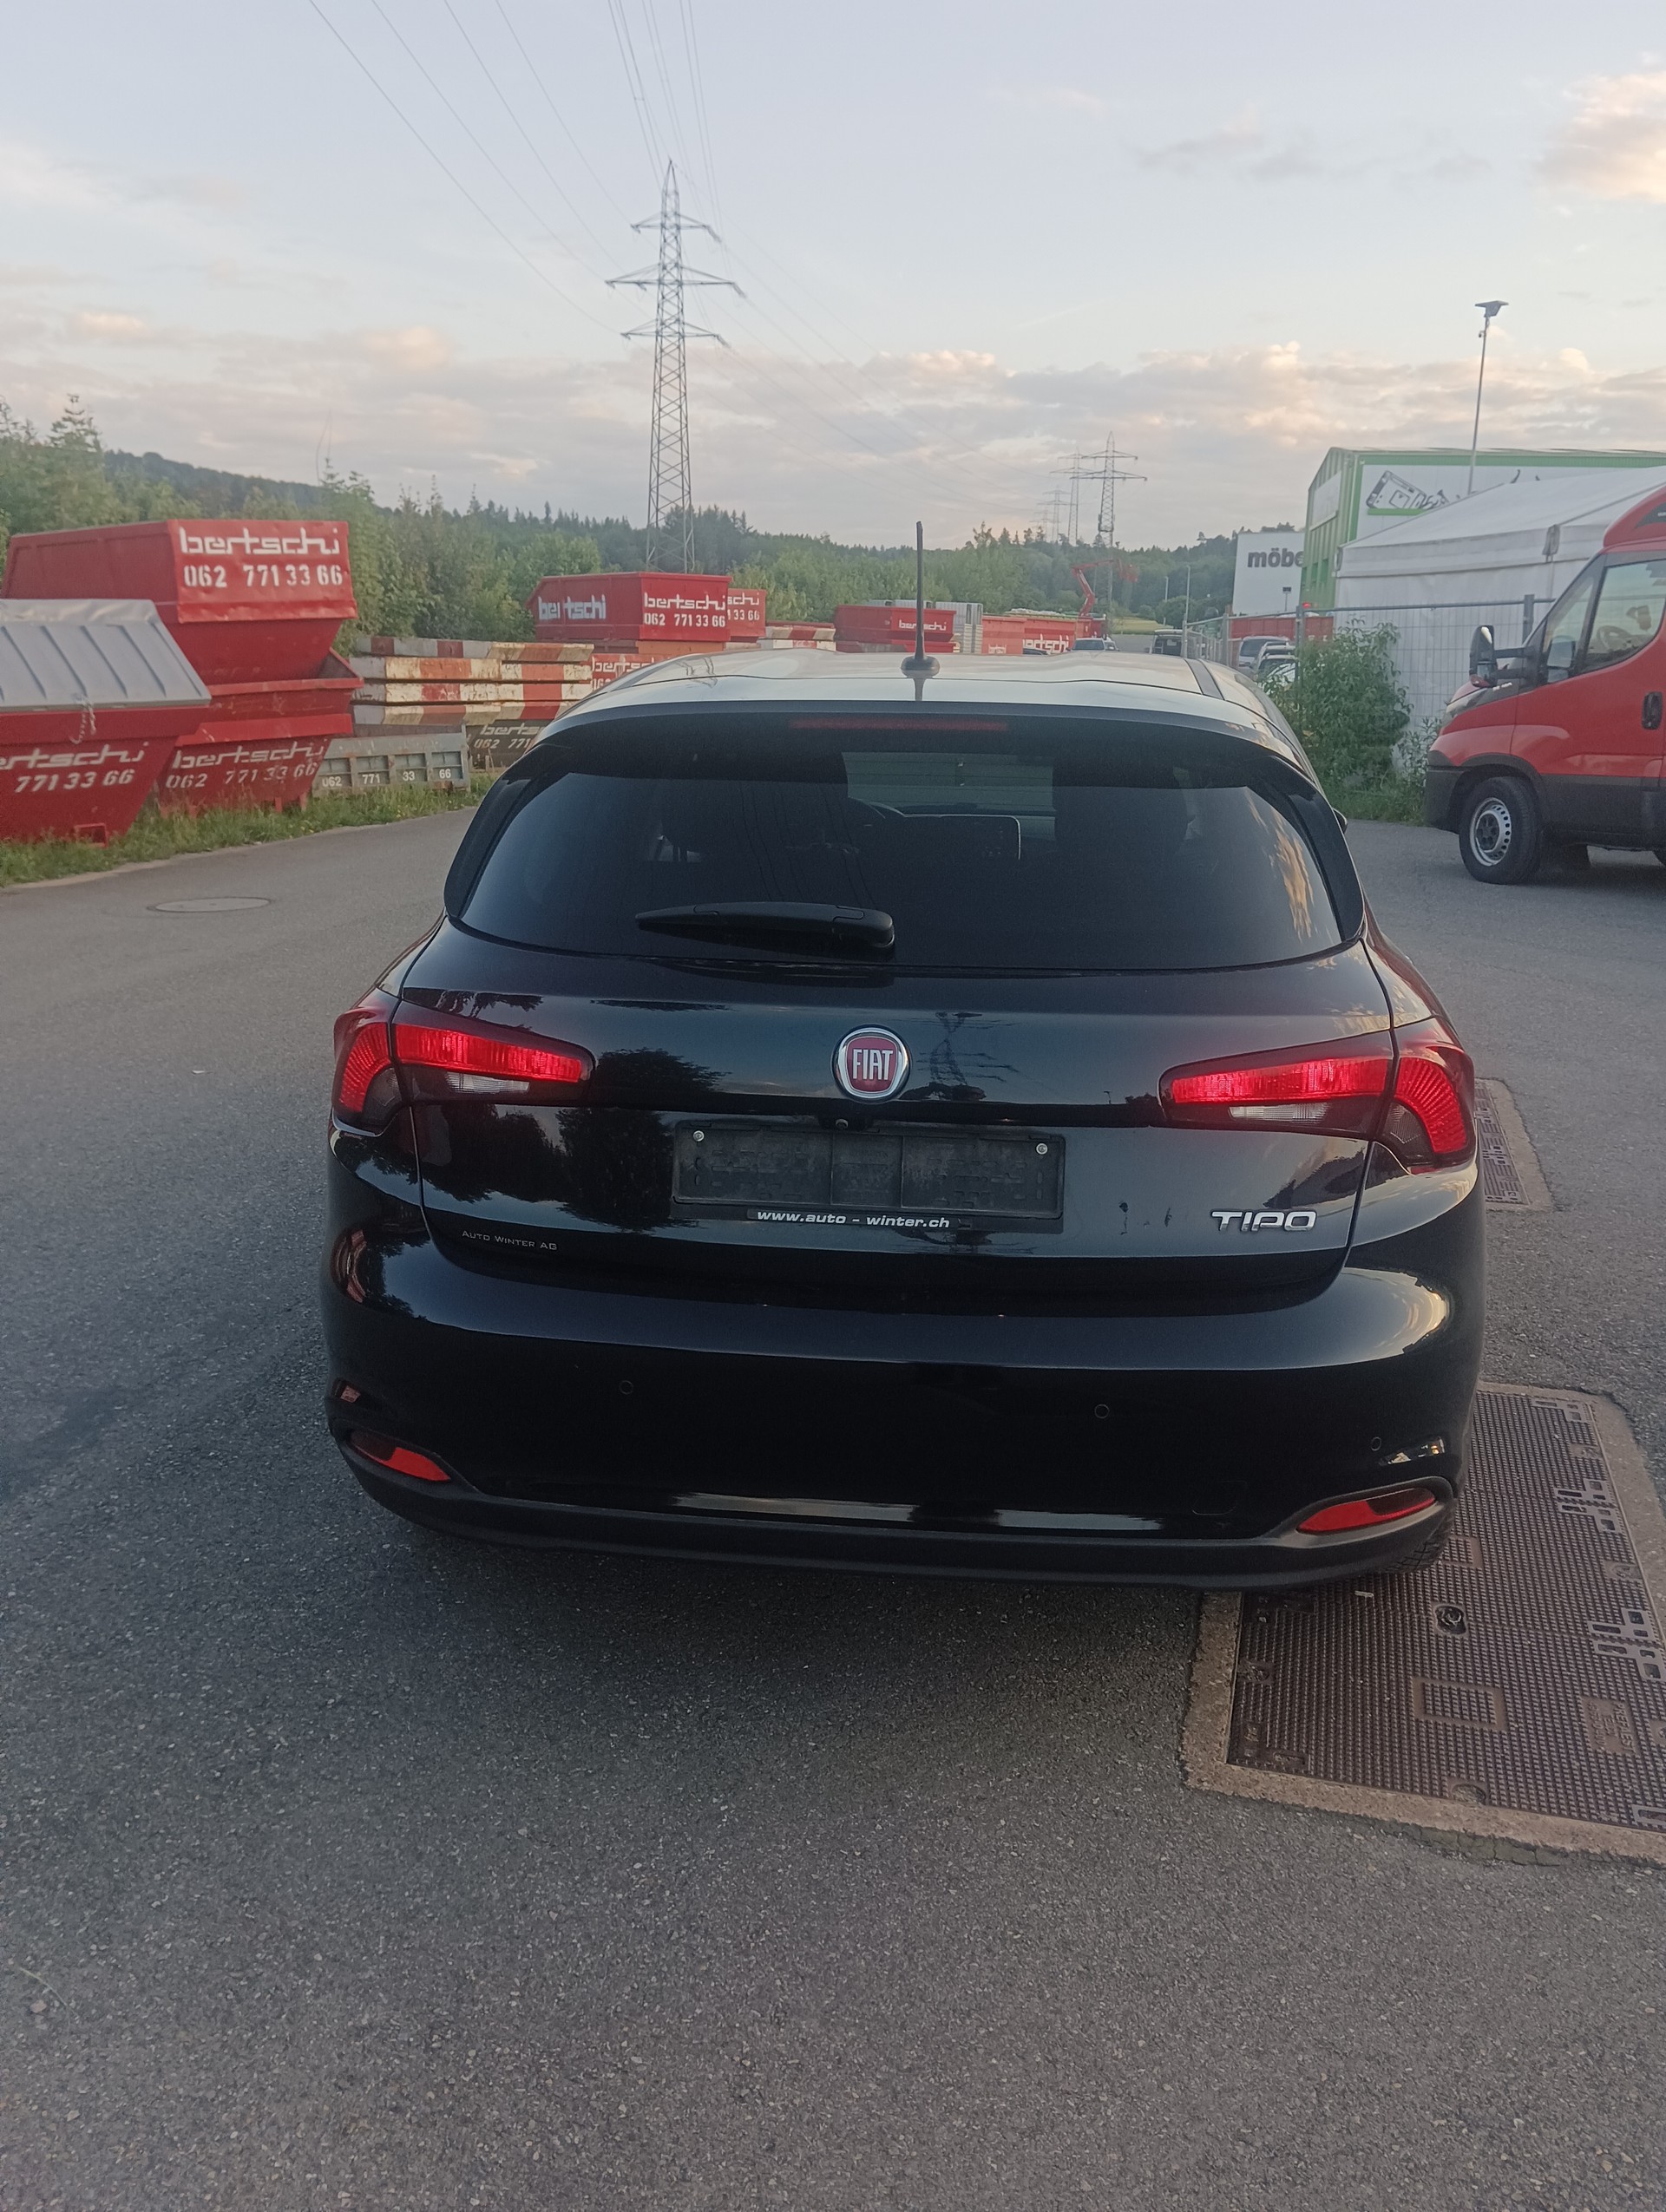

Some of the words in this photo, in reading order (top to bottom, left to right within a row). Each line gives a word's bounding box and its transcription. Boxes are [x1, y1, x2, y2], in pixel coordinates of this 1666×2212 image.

[179, 527, 340, 554] bertschi
[184, 565, 227, 587] 062
[243, 564, 280, 586] 771
[285, 564, 311, 586] 33
[317, 564, 343, 586] 66
[644, 592, 726, 611] bertschi
[644, 612, 666, 625] 062
[674, 613, 692, 626] 771
[696, 614, 709, 627] 33
[712, 615, 726, 627] 66
[734, 609, 745, 620] 33
[748, 610, 760, 621] 66
[899, 619, 947, 631] berschi
[173, 737, 328, 769] bertschi
[473, 738, 501, 749] 062
[508, 737, 531, 749] 771
[15, 773, 60, 793] 771
[63, 771, 97, 789] 33
[102, 769, 135, 786] 66
[165, 773, 208, 789] 062
[224, 769, 259, 785] 771
[264, 765, 288, 782] 33
[293, 762, 318, 778] 66
[322, 776, 343, 788] 062
[362, 773, 381, 785] 771
[403, 770, 416, 782] 33
[439, 768, 451, 779] 66
[853, 1049, 894, 1081] FIAT
[757, 1211, 847, 1224] www.auto
[866, 1215, 950, 1228] winter.ch
[1211, 1211, 1316, 1232] TIPO
[540, 1242, 558, 1251] AG
